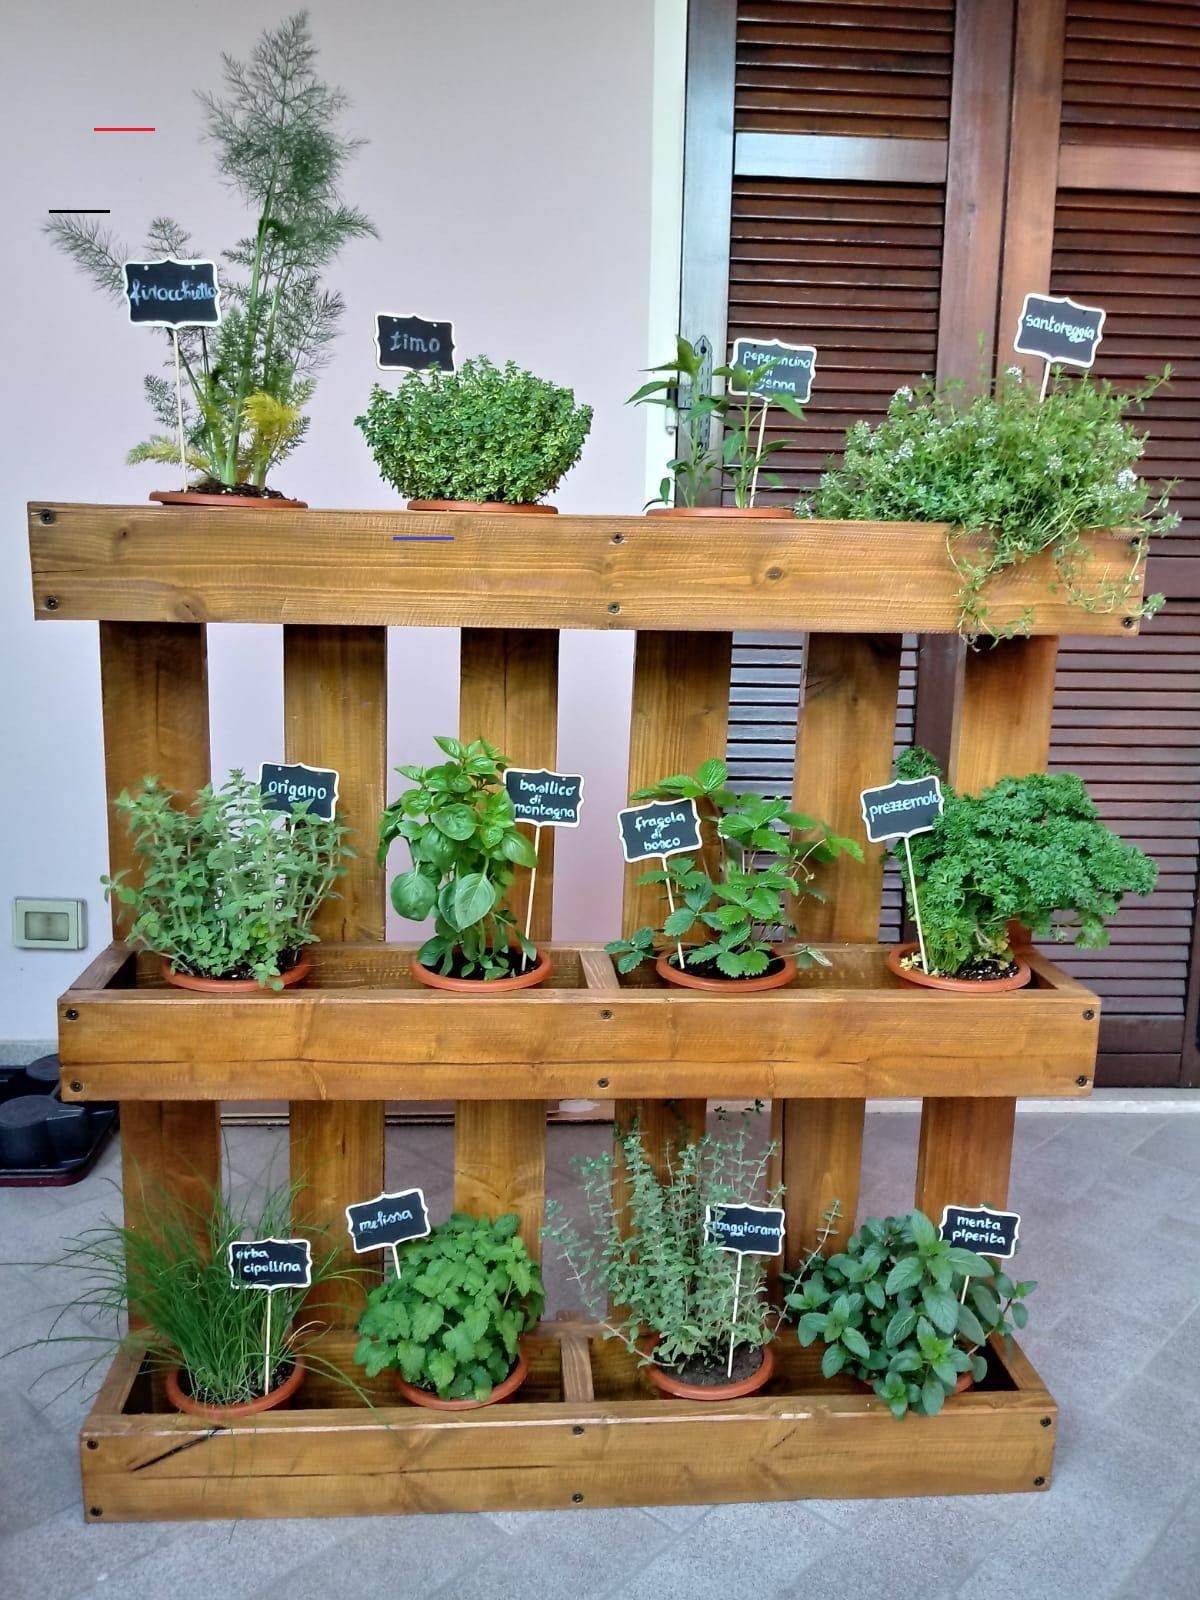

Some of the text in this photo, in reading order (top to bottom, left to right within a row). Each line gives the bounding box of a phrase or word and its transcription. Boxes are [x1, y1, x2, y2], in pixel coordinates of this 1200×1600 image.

[1025, 314, 1095, 343] santoreggia
[390, 331, 440, 352] timo
[743, 350, 811, 368] peperncino
[268, 779, 327, 802] origano
[520, 779, 577, 796] basilico
[529, 794, 542, 804] di
[514, 803, 575, 820] montagna
[635, 811, 686, 832] fragola
[651, 828, 662, 839] di
[643, 837, 680, 851] bosco
[359, 1210, 413, 1232] melissa
[957, 1216, 1001, 1231] menta
[952, 1229, 1006, 1246] piperita
[235, 1248, 270, 1260] erba
[243, 1260, 301, 1276] cipollina
